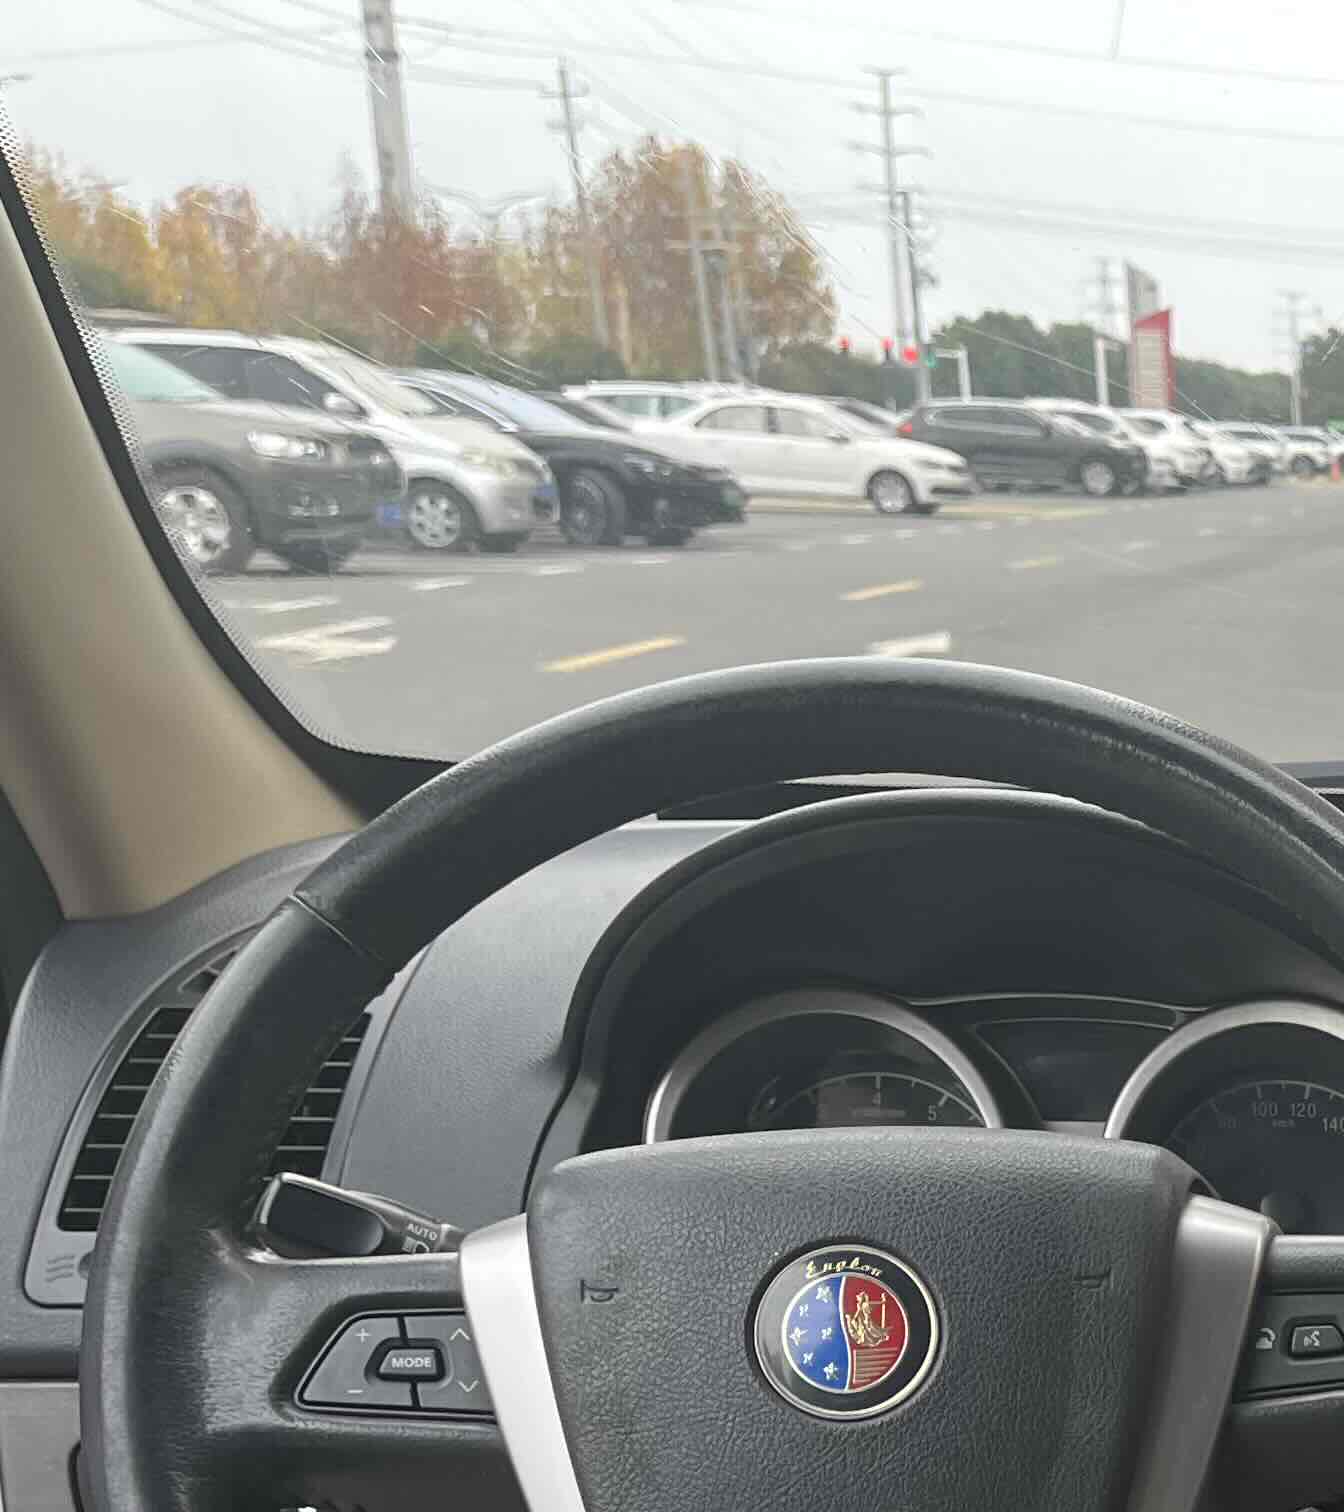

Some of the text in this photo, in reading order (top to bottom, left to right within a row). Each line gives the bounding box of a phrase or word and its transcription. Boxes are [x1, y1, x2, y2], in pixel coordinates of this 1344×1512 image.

[927, 1105, 938, 1121] 5
[1252, 1102, 1279, 1117] 100
[1290, 1102, 1317, 1117] 120
[407, 1223, 438, 1241] AUTO
[391, 1356, 432, 1369] MODE
